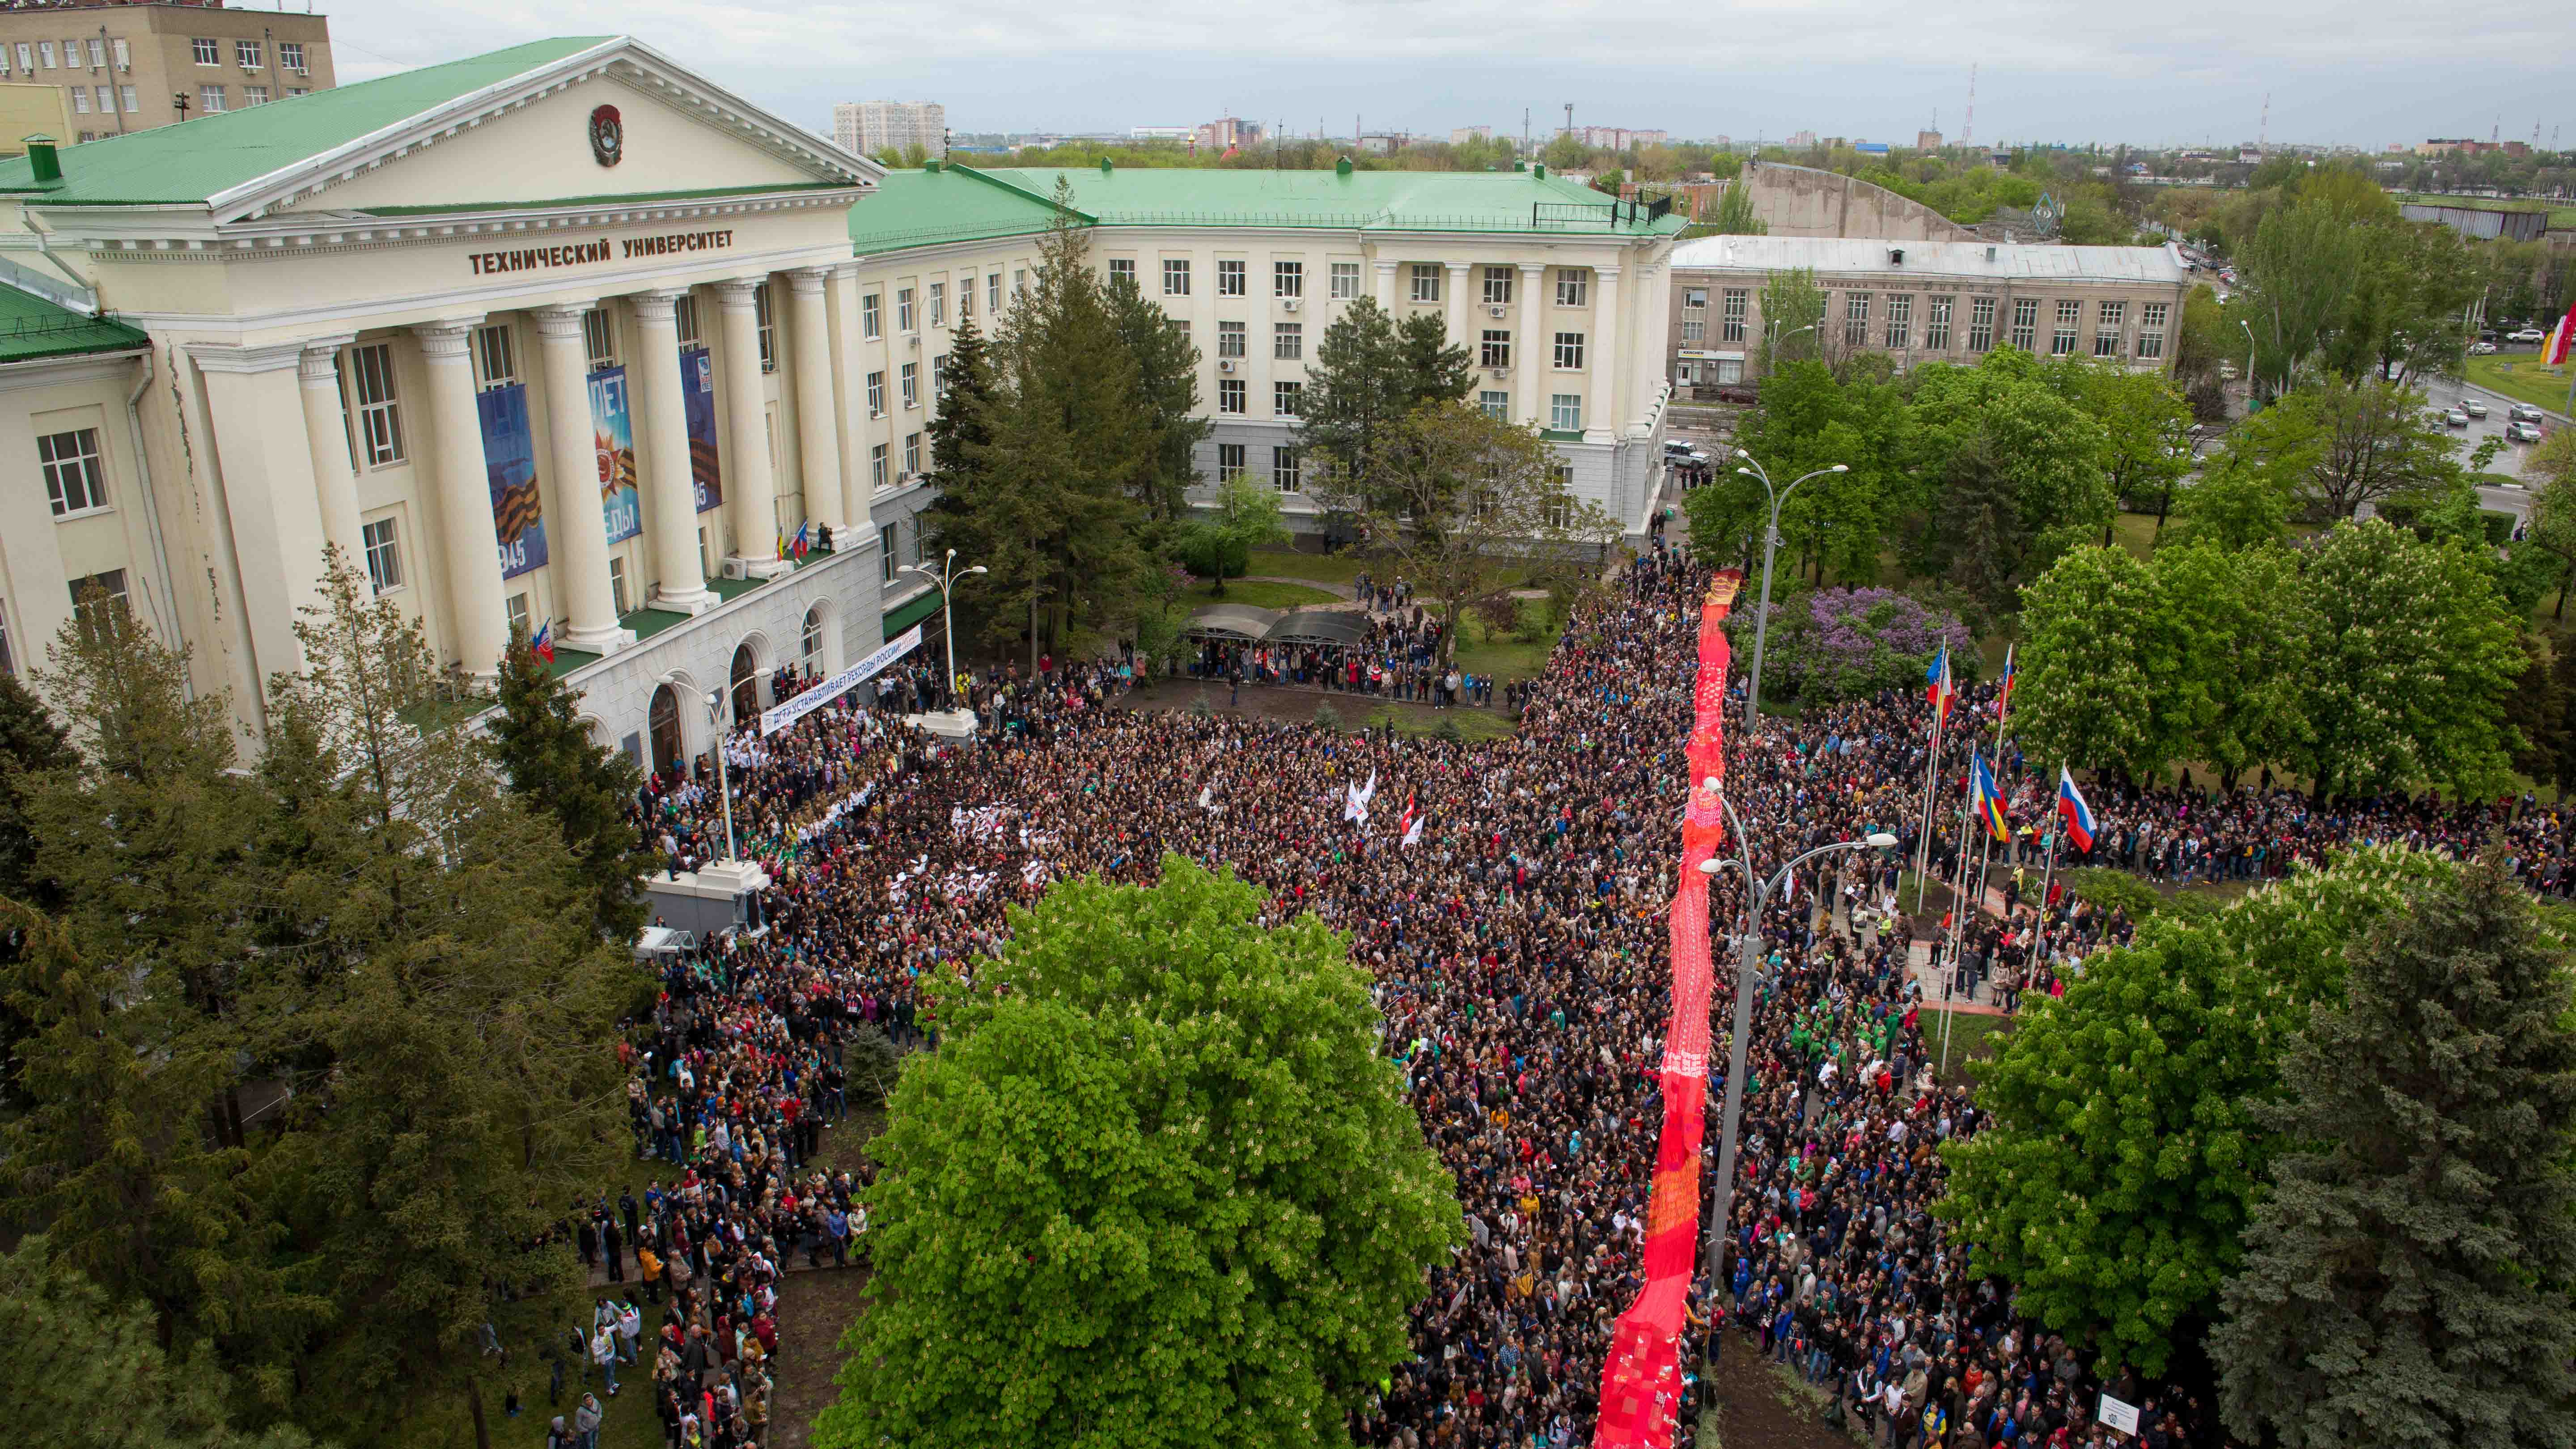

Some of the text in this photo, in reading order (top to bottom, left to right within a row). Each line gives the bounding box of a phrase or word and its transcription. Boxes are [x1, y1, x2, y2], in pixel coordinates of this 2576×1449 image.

[469, 230, 733, 275] ТЕХНИЧЕСКИЙ УНИВЕРСИТЕТ
[590, 374, 624, 420] ЛЕТ
[774, 641, 902, 726] ДГТУ УСТАНАВЛИВАЕТ РЕКОРДЫ РОССИИ!
